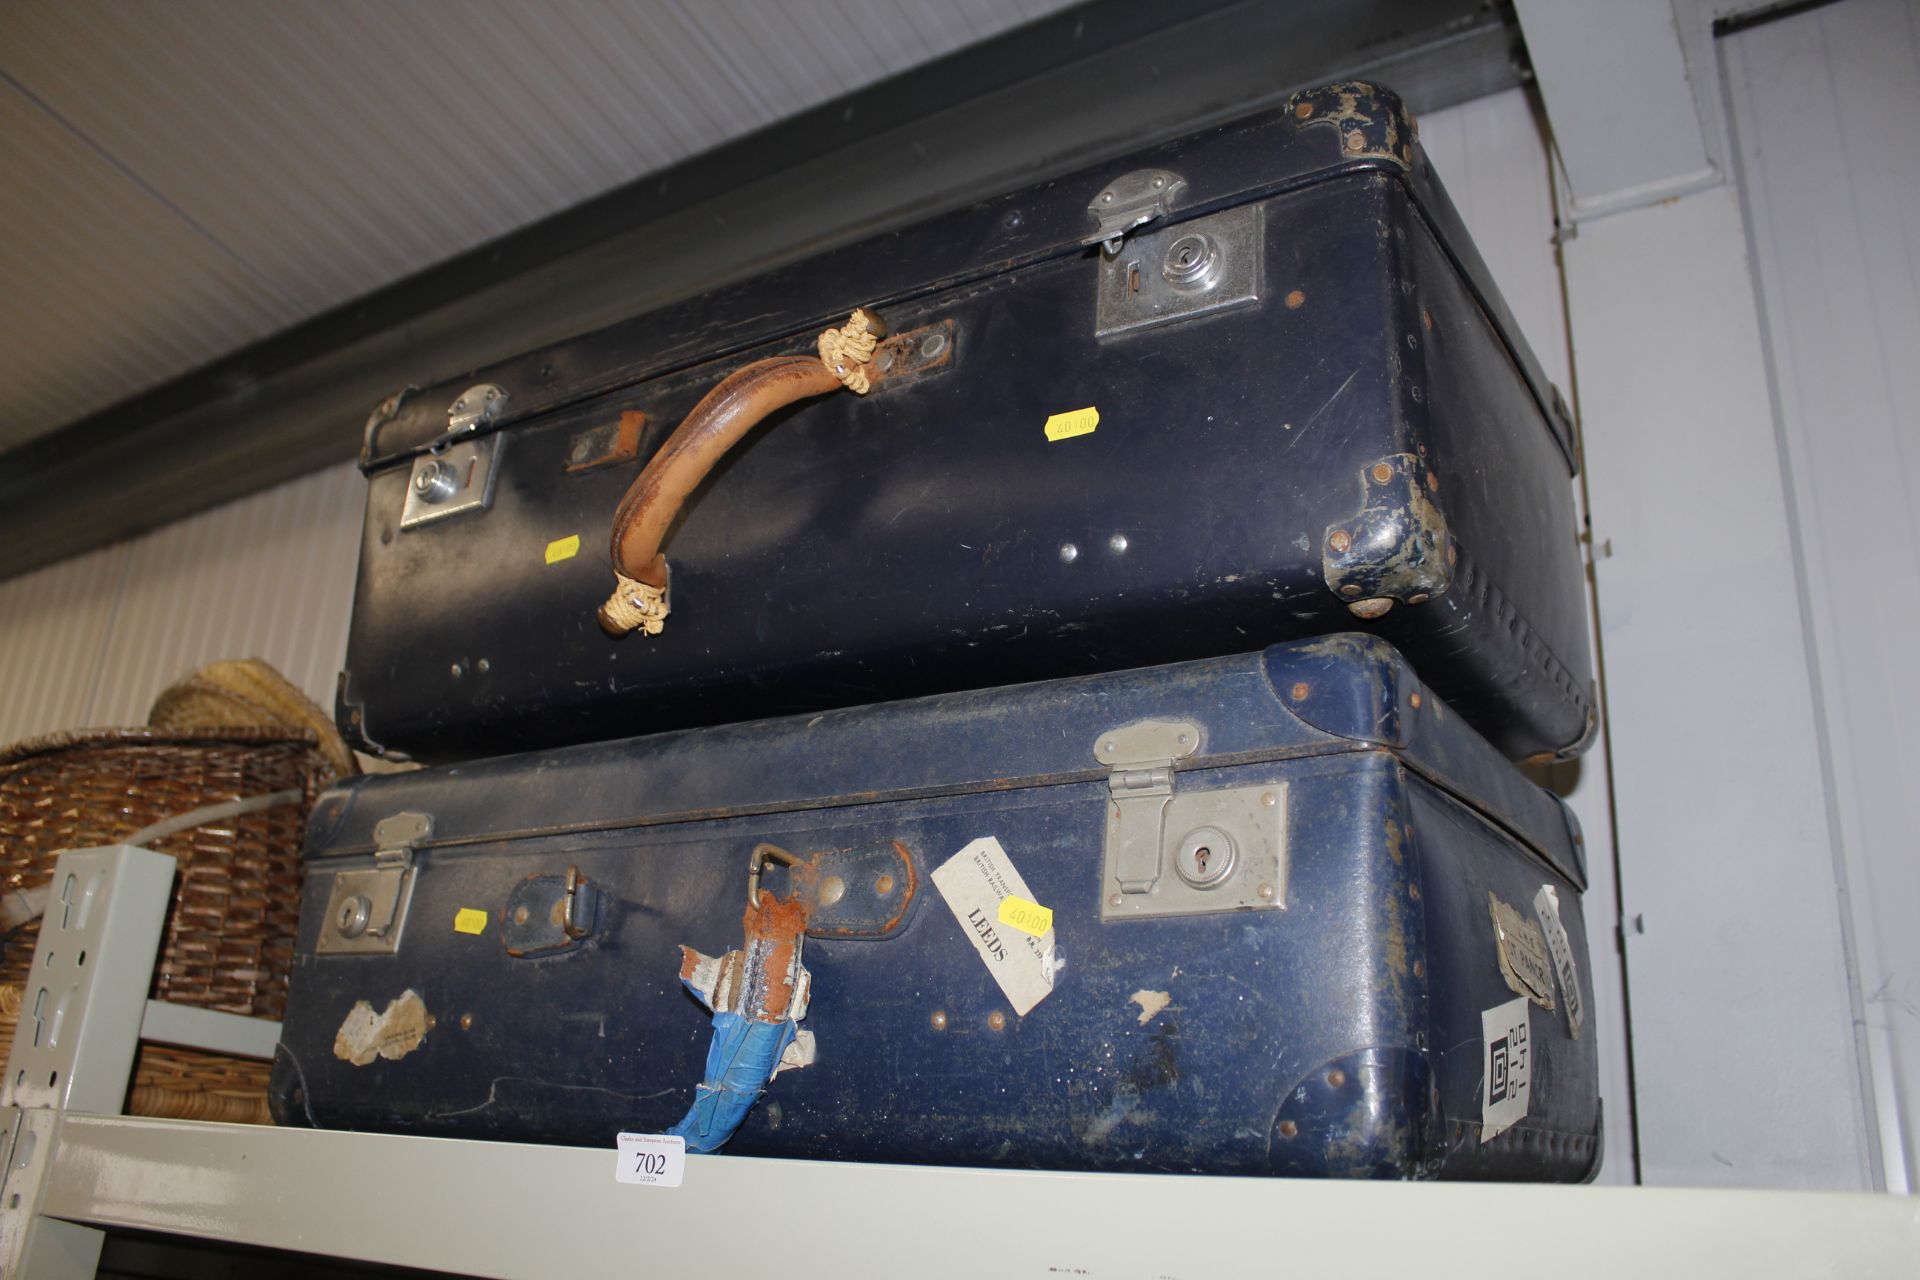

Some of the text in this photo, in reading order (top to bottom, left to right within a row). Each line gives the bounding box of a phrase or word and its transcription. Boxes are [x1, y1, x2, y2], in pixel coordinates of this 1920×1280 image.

[974, 855, 989, 878] BRITISH
[981, 851, 995, 872] BRITISH
[968, 907, 1008, 962] LEEDS
[636, 1152, 666, 1175] 702
